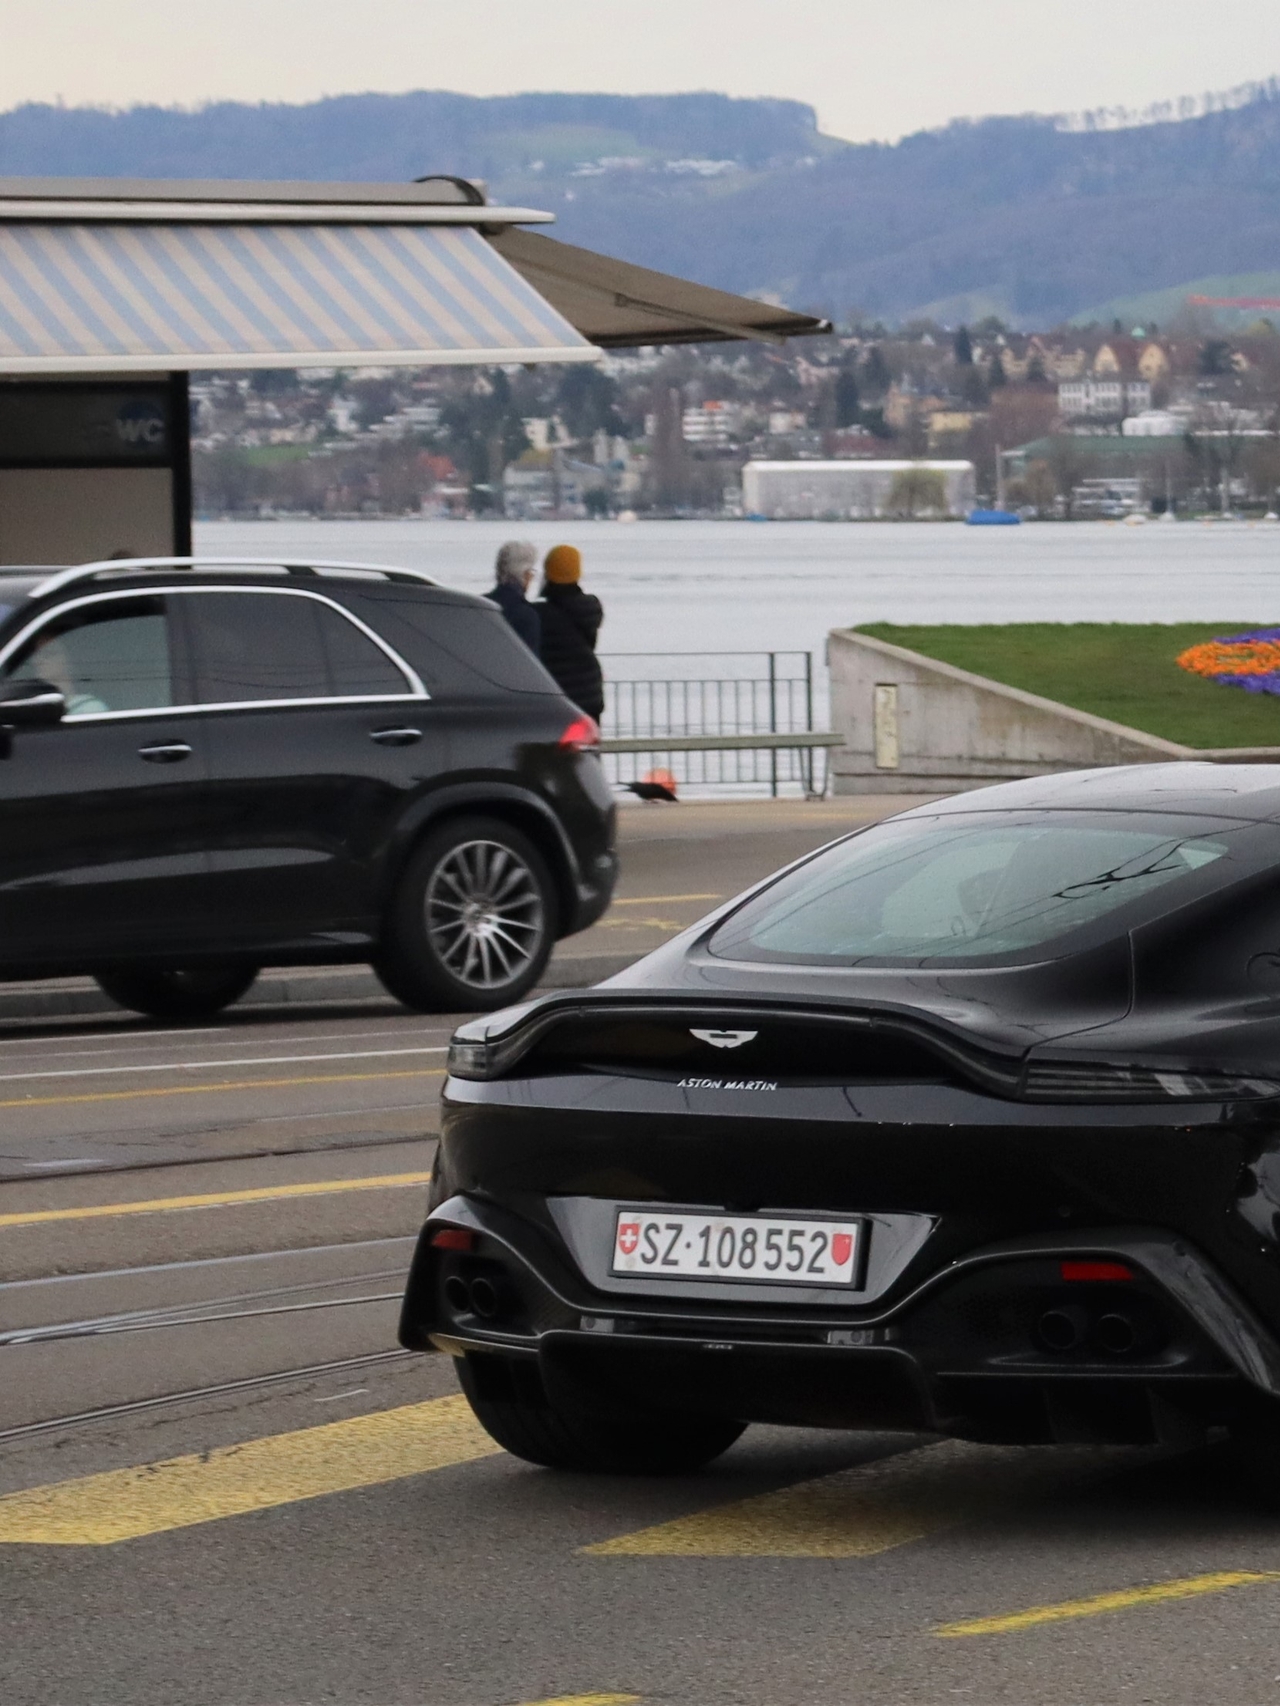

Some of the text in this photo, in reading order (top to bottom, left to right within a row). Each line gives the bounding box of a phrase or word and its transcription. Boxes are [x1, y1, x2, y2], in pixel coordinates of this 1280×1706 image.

[116, 418, 165, 442] WC
[677, 1078, 778, 1091] ASTON MARTIN
